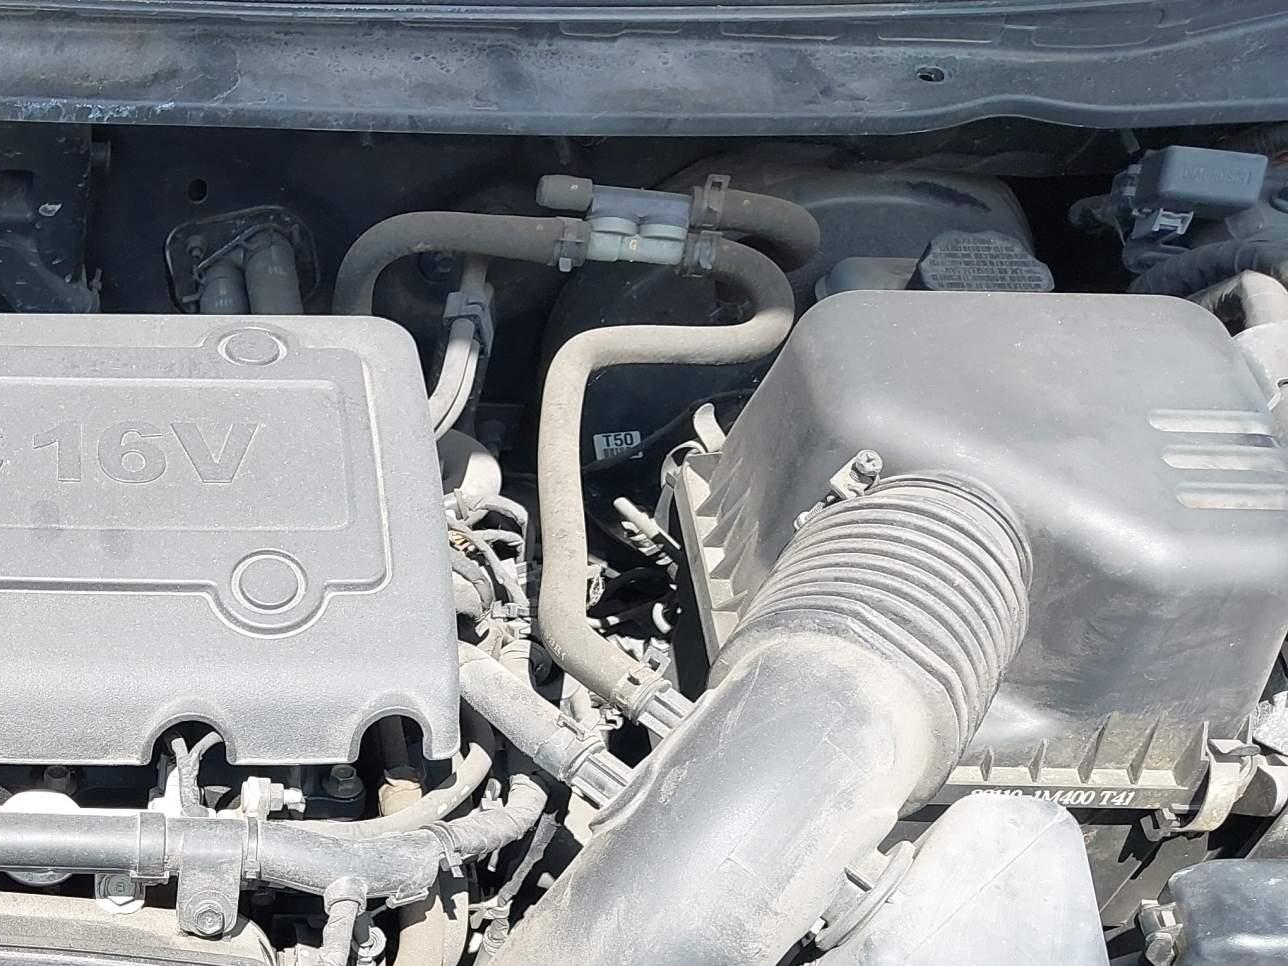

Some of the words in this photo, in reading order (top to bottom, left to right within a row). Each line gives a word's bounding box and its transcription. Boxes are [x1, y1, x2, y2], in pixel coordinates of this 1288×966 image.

[601, 432, 634, 448] T50
[32, 421, 261, 485] 16V
[1098, 791, 1136, 806] T41
